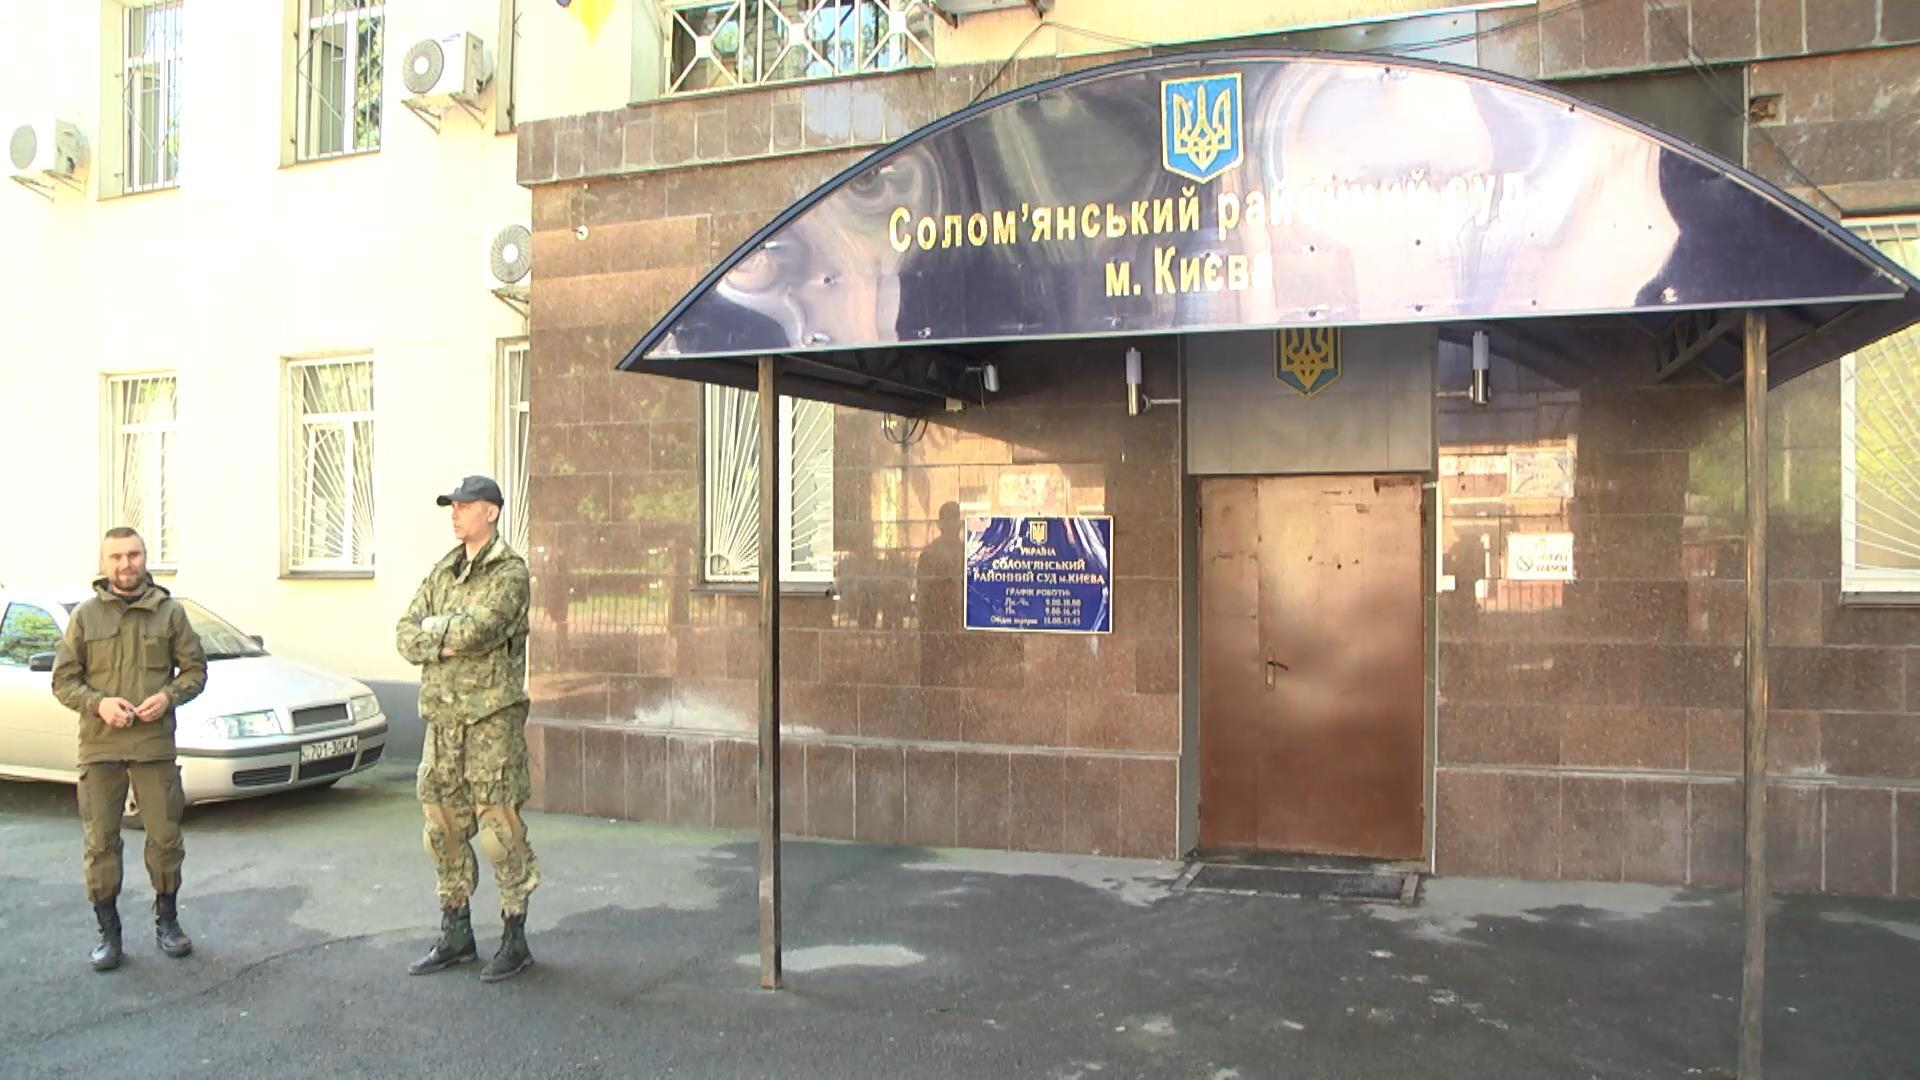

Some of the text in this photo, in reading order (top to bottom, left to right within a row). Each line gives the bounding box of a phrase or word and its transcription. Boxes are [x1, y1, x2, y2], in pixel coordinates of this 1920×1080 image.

[889, 185, 1199, 252] Солом'янський
[1105, 245, 1273, 297] м. Києва
[1020, 547, 1056, 556] УКРАЇНА
[974, 570, 1034, 583] РАЙОННИЙ
[1036, 573, 1057, 584] СУД
